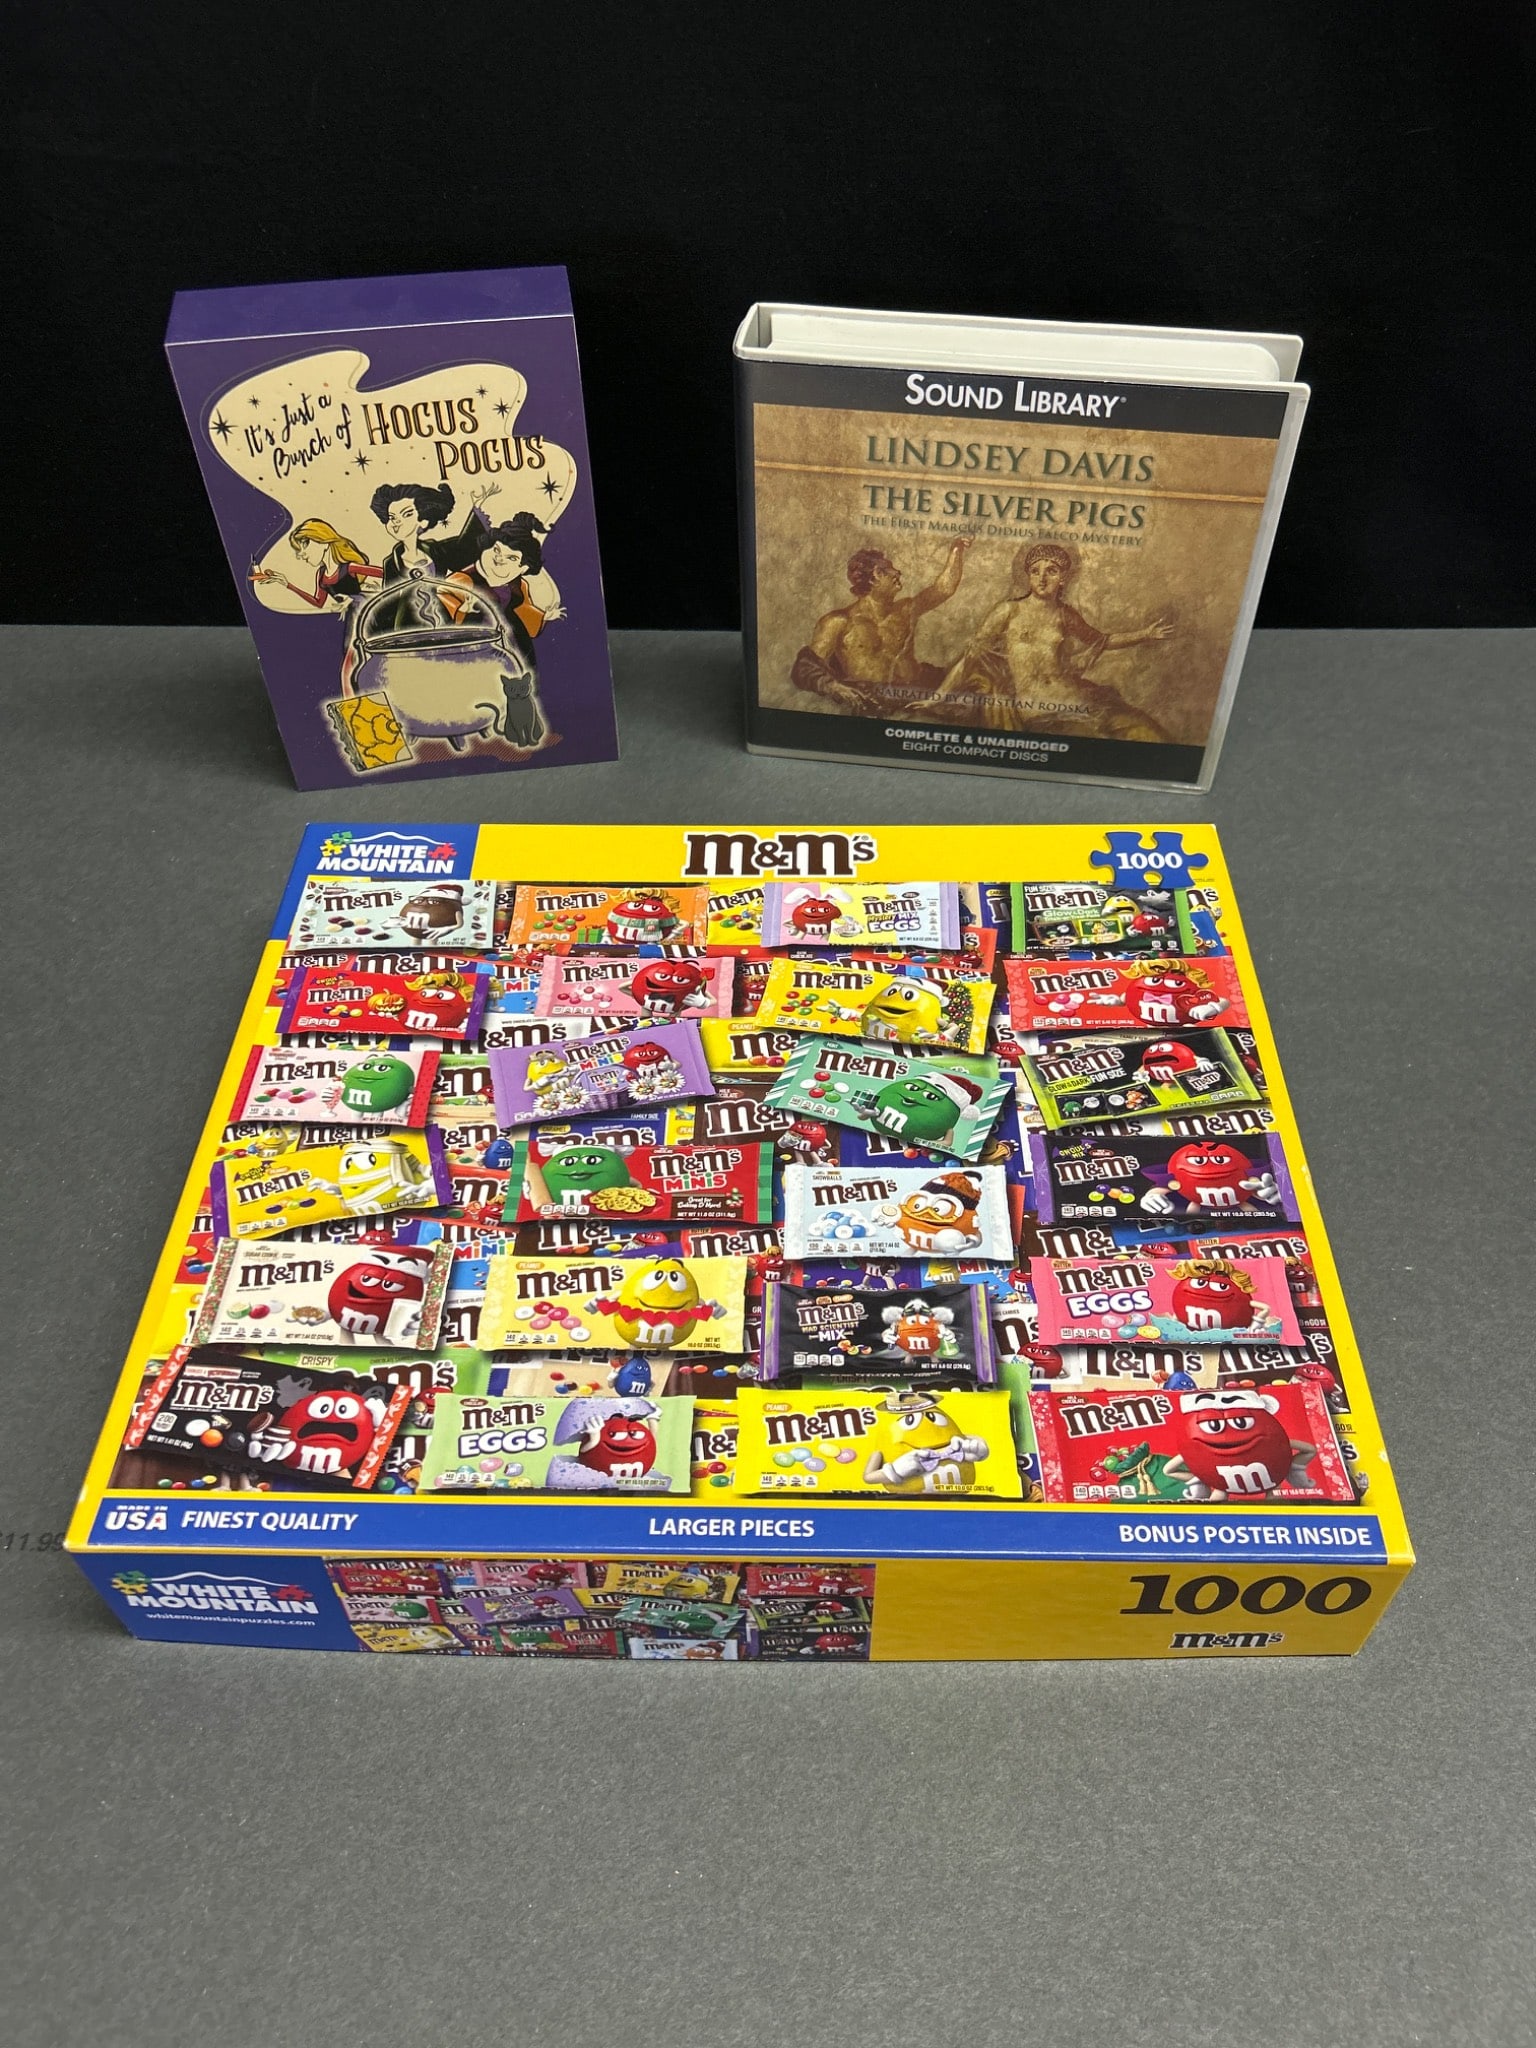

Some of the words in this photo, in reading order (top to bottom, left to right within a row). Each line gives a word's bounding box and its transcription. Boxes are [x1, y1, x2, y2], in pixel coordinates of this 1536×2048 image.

[244, 424, 275, 457] It's
[281, 393, 315, 441] Just
[318, 394, 332, 408] a
[361, 398, 479, 446] HOCUS
[273, 429, 332, 479] Bunch
[336, 403, 353, 450] of
[434, 435, 546, 480] POCUS
[866, 436, 1029, 473] LINDSEY
[1042, 449, 1154, 482] DAVIS
[863, 484, 932, 513] THE
[943, 491, 1057, 524] SILVER
[1067, 500, 1146, 529] PIGS
[885, 728, 959, 744] COMPLETE
[963, 735, 973, 745] &
[977, 736, 1070, 753] UNABRIDGED
[902, 741, 939, 754] EIGHT
[943, 745, 1005, 760] COMPACT
[1009, 750, 1049, 763] DISCS
[350, 844, 429, 859] WHITE
[684, 833, 876, 876] m&m's
[1116, 852, 1183, 870] 1000
[316, 857, 454, 875] MOUNTAIN
[323, 890, 403, 913] m&m's
[536, 891, 607, 913] m&m's
[863, 898, 923, 915] m&m's
[1026, 888, 1108, 910] m&m's
[867, 918, 921, 933] EGGS
[563, 962, 638, 983] m&m's
[793, 971, 874, 990] m&m's
[1031, 969, 1118, 993] m&m's
[308, 987, 373, 1003] m&m's
[564, 1037, 631, 1063] m&m's
[262, 1060, 348, 1082] m&m's
[815, 1049, 908, 1080] m&m's
[1040, 1048, 1123, 1081] m&m's
[652, 1149, 741, 1177] m&m's
[1055, 1155, 1139, 1182] m&m's
[237, 1169, 311, 1203] m&m's
[811, 1179, 898, 1206] m&m's
[238, 1260, 335, 1288] m&m's
[516, 1266, 624, 1300] m&m's
[1056, 1262, 1155, 1295] m&m's
[798, 1301, 865, 1327] m&m's
[1067, 1290, 1153, 1318] EGGS
[818, 1329, 846, 1342] MIX
[820, 1322, 860, 1332] SCIENTIST
[301, 1355, 334, 1367] CRISPY
[171, 1380, 273, 1411] m&m's
[462, 1403, 545, 1431] m&m's
[765, 1407, 877, 1445] m&m's
[1061, 1395, 1172, 1437] m&m's
[458, 1427, 547, 1458] EGGS
[105, 1511, 168, 1531] USA
[181, 1511, 259, 1530] FINEST
[262, 1512, 358, 1532] QUALITY
[649, 1518, 735, 1536] LARGER
[741, 1519, 815, 1538] PIECES
[0, 1532, 65, 1552] 11.99
[1119, 1525, 1199, 1543] BONUS
[1203, 1525, 1292, 1545] POSTER
[1296, 1527, 1372, 1546] INSIDE
[151, 1583, 271, 1600] WHITE
[1119, 1574, 1373, 1616] 1000
[126, 1595, 319, 1615] MOUNTAIN
[146, 1612, 316, 1627] whitemountainpuzzles.com
[1169, 1631, 1286, 1649] m&m's
